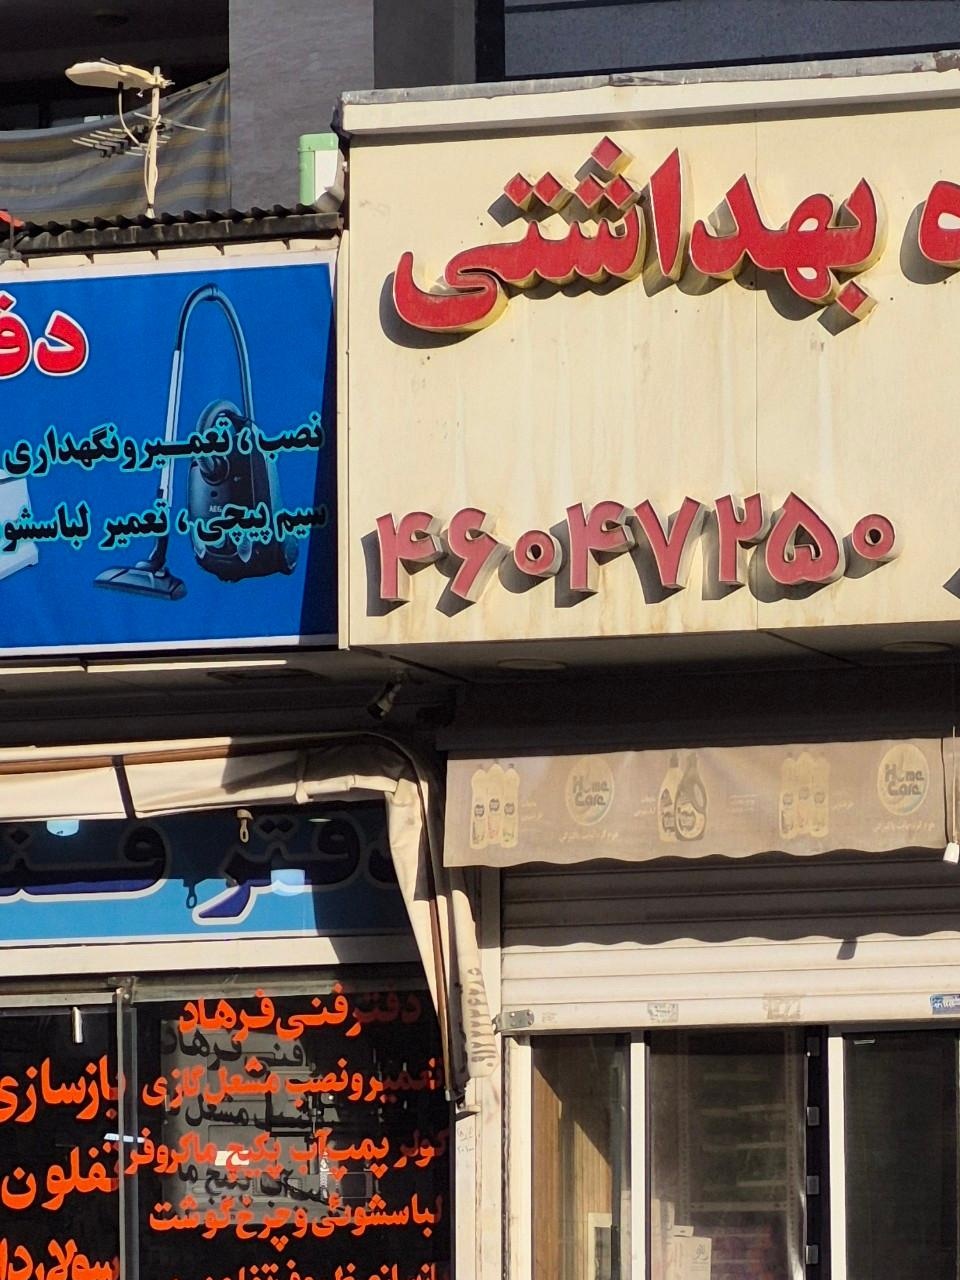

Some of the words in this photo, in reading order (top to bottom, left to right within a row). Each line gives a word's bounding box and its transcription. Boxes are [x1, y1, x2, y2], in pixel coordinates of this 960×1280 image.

[393, 136, 880, 330] بهداشتی
[256, 413, 325, 462] نصب
[99, 498, 169, 547] تعمیر
[179, 988, 276, 1041] فرهاد
[276, 983, 348, 1038] فنی
[148, 1195, 234, 1240] گوشت
